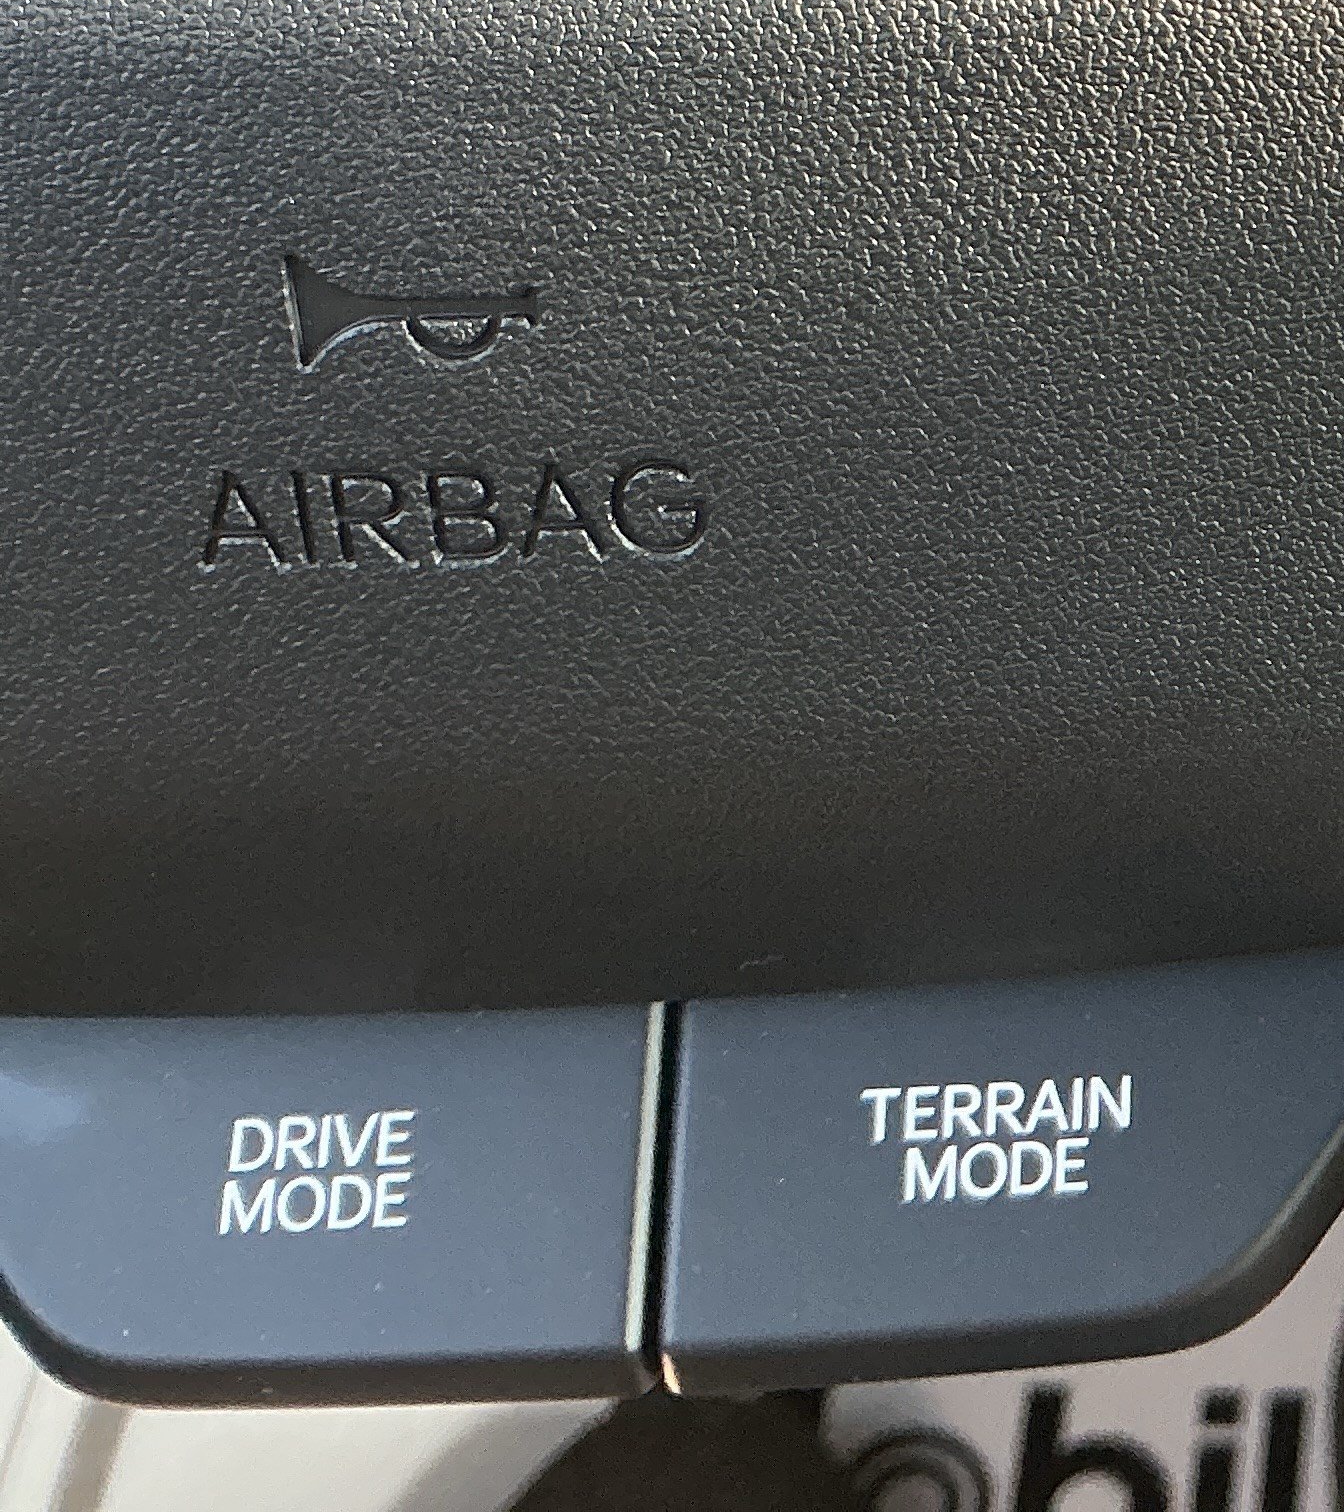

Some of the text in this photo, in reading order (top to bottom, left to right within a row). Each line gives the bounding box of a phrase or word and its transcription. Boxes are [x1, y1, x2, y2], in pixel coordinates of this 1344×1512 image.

[199, 462, 706, 570] AIRBAG
[228, 1110, 415, 1173] DRIVE
[859, 1073, 1132, 1145] TERRAIN
[219, 1171, 412, 1235] MODE
[902, 1137, 1090, 1204] MODE
